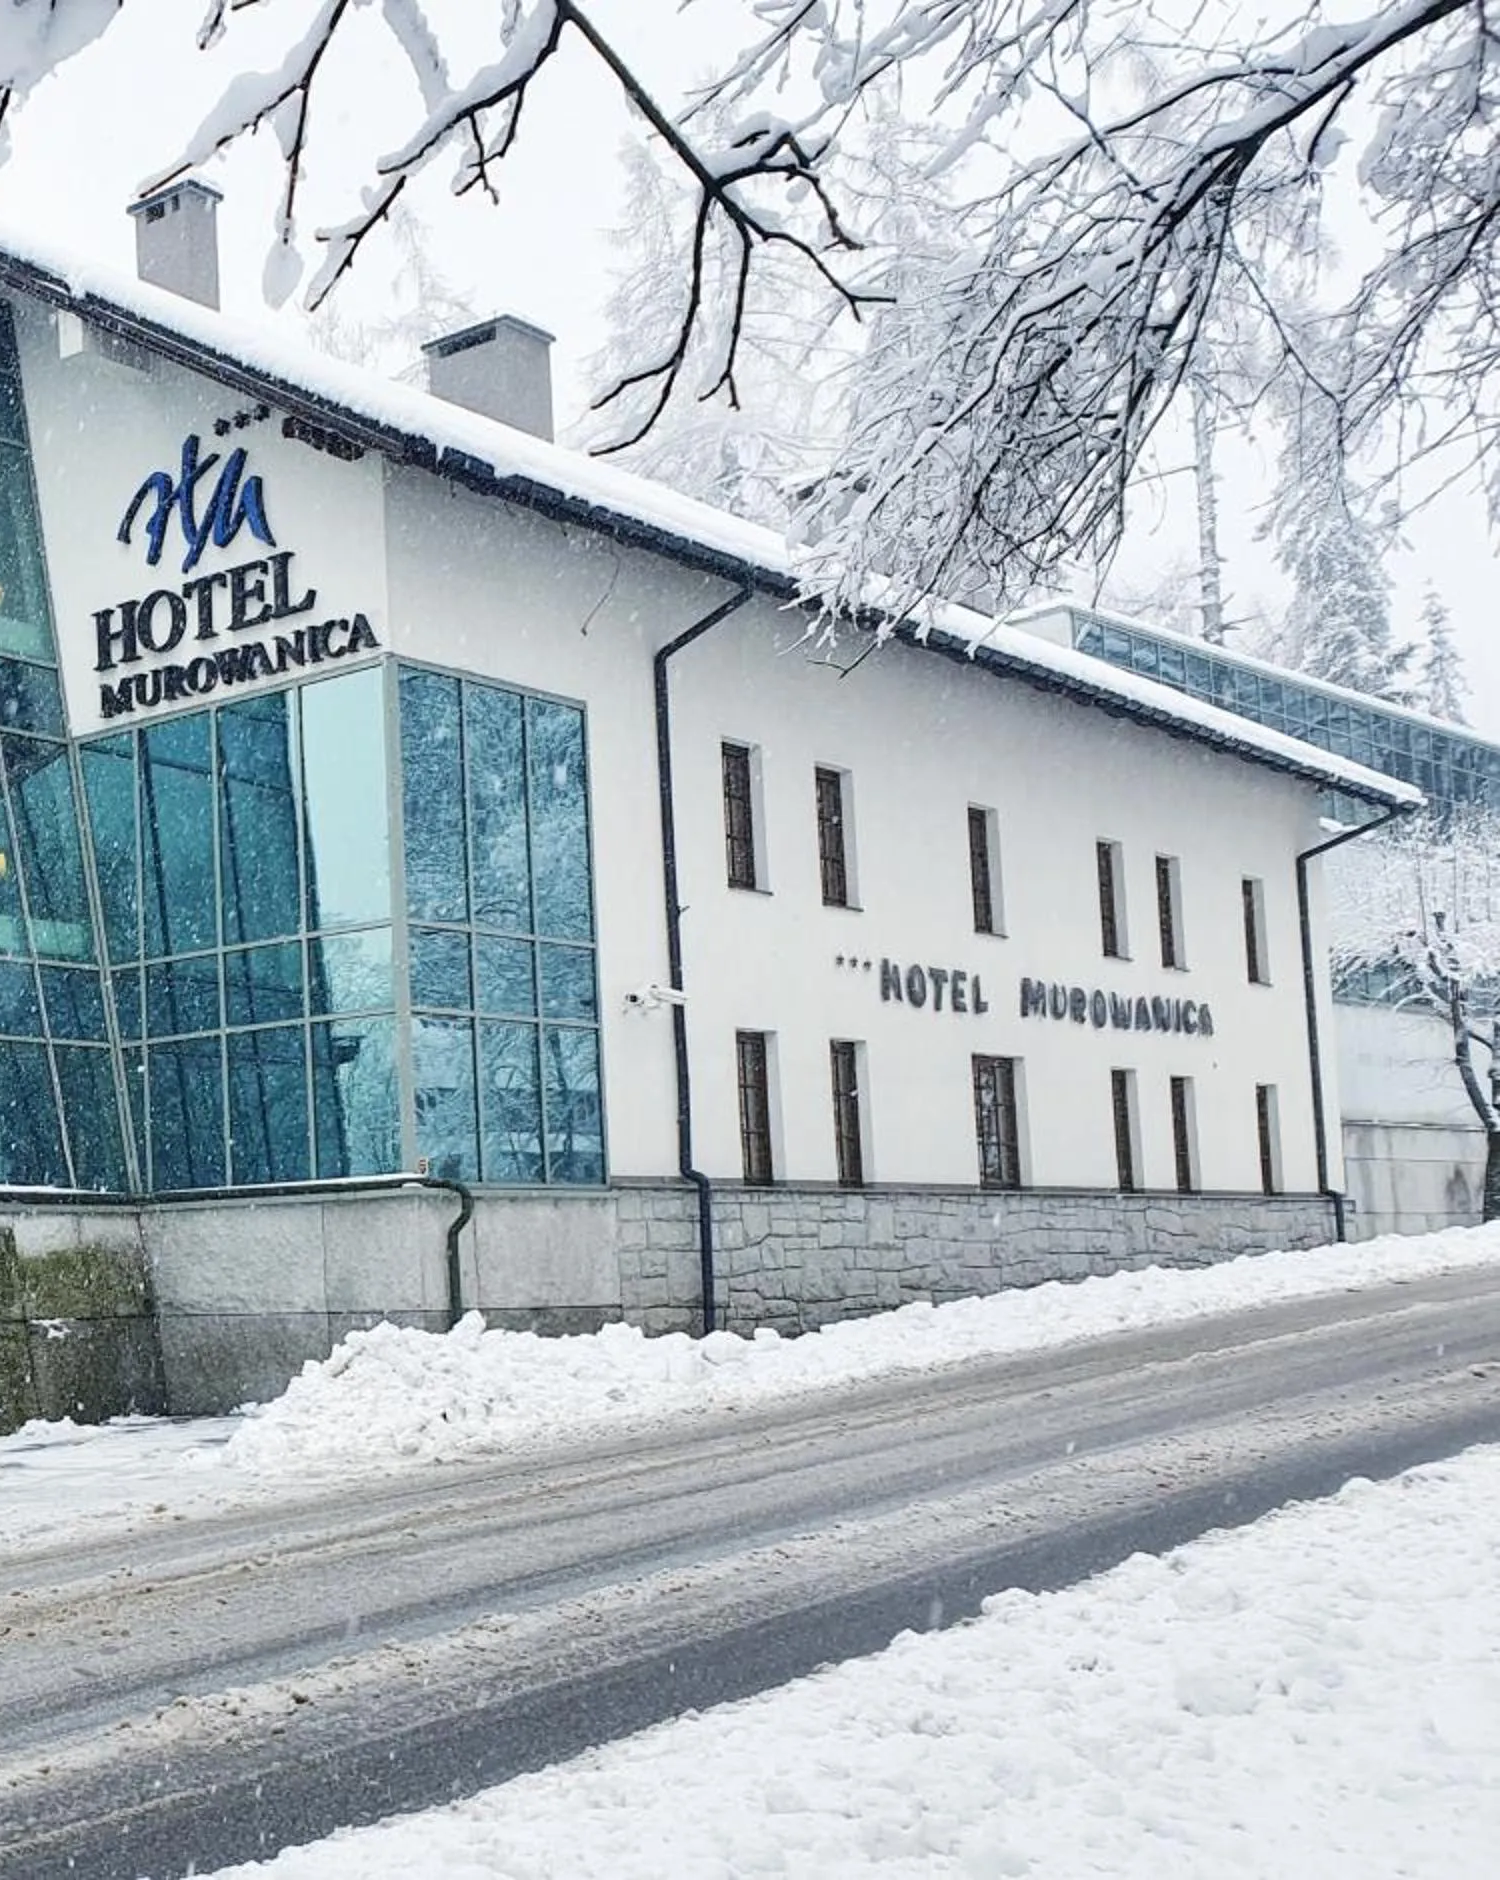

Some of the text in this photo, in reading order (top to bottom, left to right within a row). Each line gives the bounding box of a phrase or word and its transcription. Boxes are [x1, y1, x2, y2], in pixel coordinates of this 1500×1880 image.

[91, 550, 317, 672] HOTEL
[99, 612, 381, 719] MUROWANICA
[879, 957, 1216, 1037] HOTEL MUROWANICA
